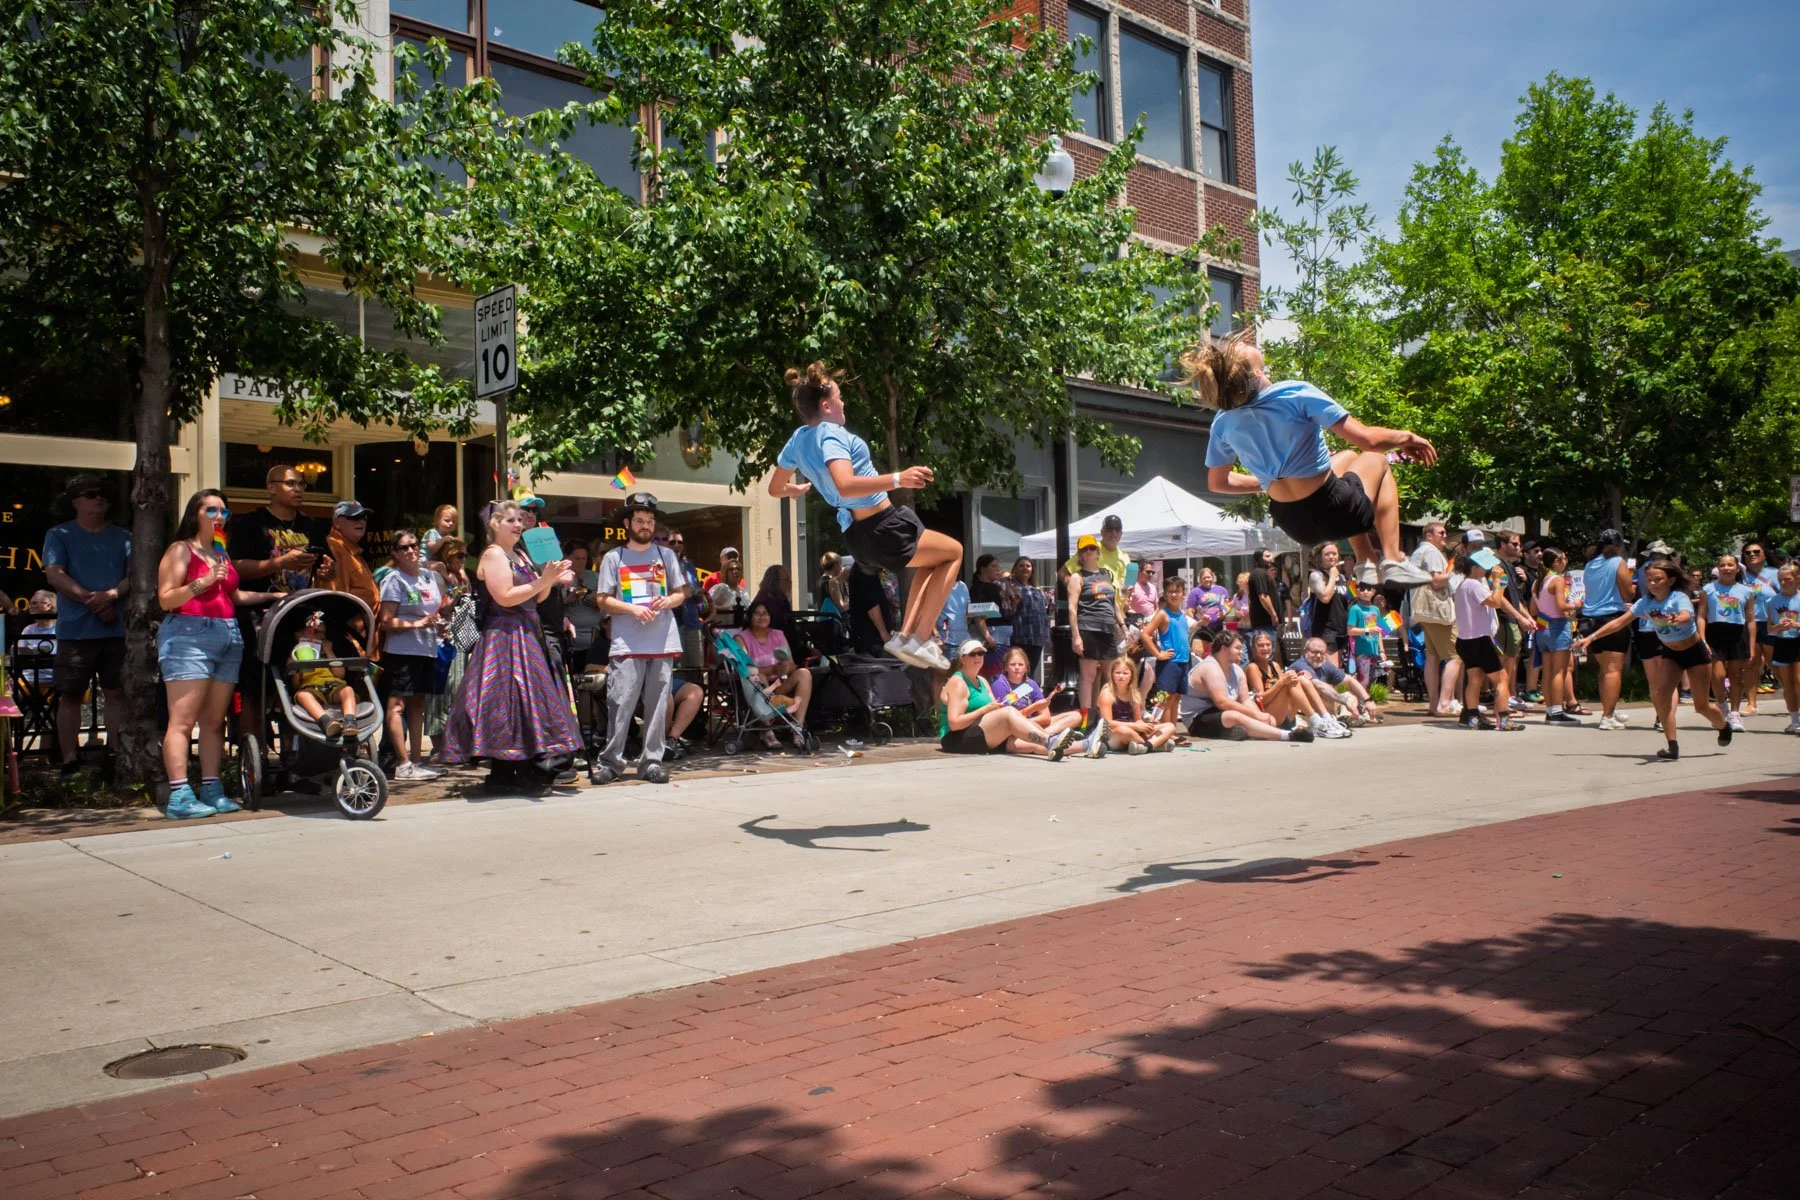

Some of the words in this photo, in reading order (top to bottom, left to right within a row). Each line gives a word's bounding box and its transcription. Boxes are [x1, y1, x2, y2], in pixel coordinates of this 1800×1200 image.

[477, 297, 513, 322] SPEED
[481, 320, 509, 342] LIMIT
[482, 344, 510, 384] 10
